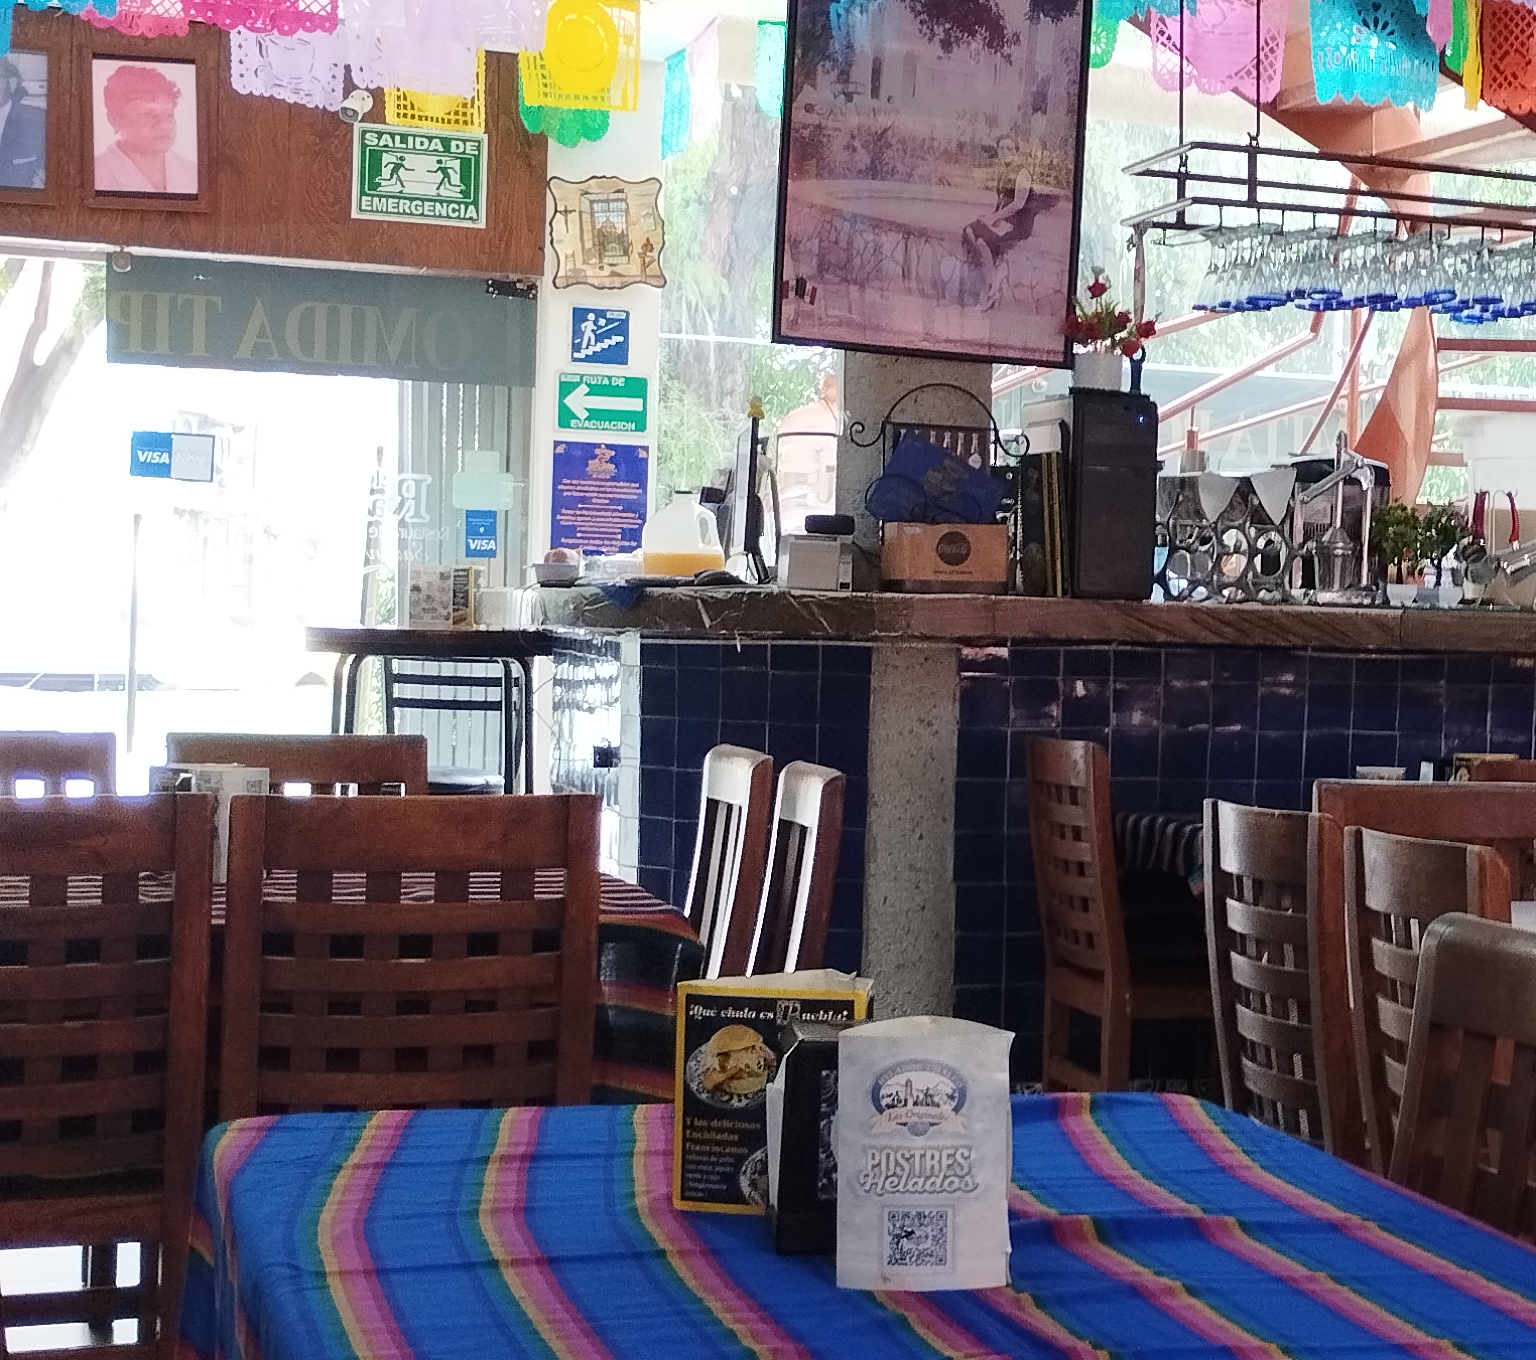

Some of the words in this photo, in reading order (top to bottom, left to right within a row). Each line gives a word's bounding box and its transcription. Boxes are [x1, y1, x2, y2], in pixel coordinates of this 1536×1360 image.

[364, 132, 445, 152] SALIDA
[450, 140, 479, 155] DE
[361, 196, 478, 219] EMERGENCIA
[582, 375, 610, 386] RUTA
[611, 377, 626, 387] DE
[136, 449, 170, 464] VISA
[467, 539, 497, 551] VISA
[866, 1147, 972, 1177] POSTRES
[859, 1168, 979, 1197] Helados
